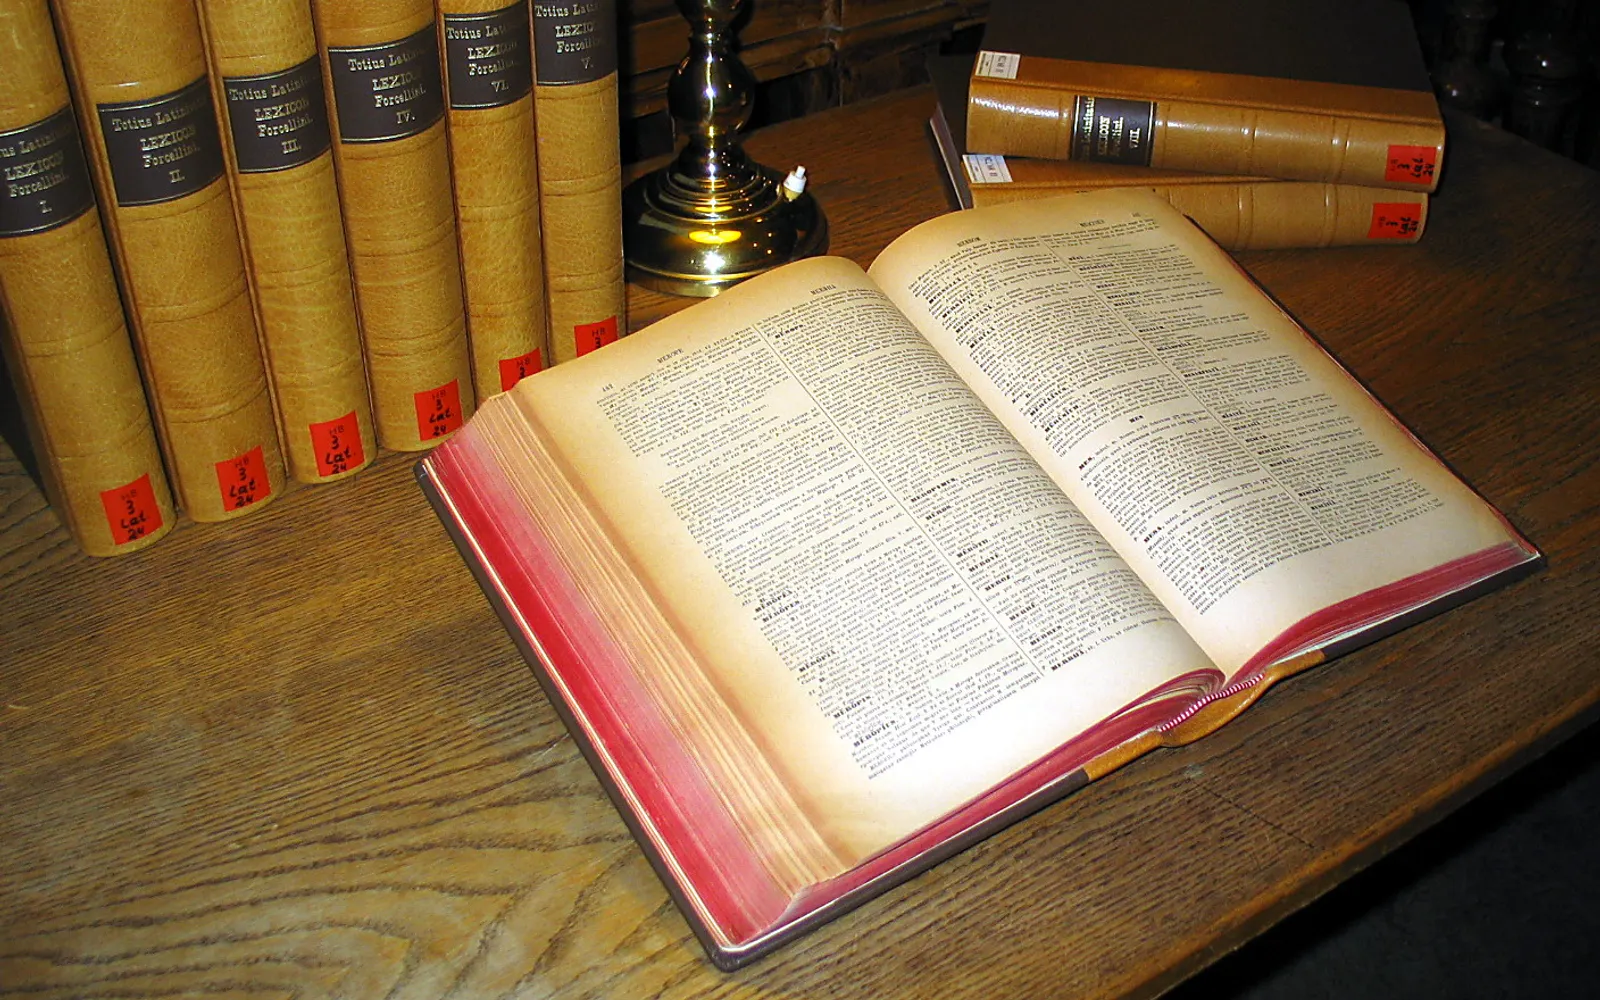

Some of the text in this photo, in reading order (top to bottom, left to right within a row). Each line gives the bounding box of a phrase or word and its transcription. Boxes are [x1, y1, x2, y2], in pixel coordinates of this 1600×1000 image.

[535, 5, 569, 17] Totius
[447, 26, 481, 39] Totius
[347, 57, 385, 71] Totius
[491, 81, 509, 92] VI.
[229, 88, 267, 101] Totius
[396, 108, 416, 124] IV.
[112, 116, 152, 132] Totius
[257, 114, 313, 138] Forcellini.
[281, 139, 301, 154] III.
[142, 144, 201, 168] Forcellini.
[169, 169, 185, 183] II.
[39, 200, 52, 214] I.
[331, 435, 339, 449] 3
[239, 467, 247, 480] 3
[331, 462, 347, 474] 24
[125, 500, 135, 515] 3
